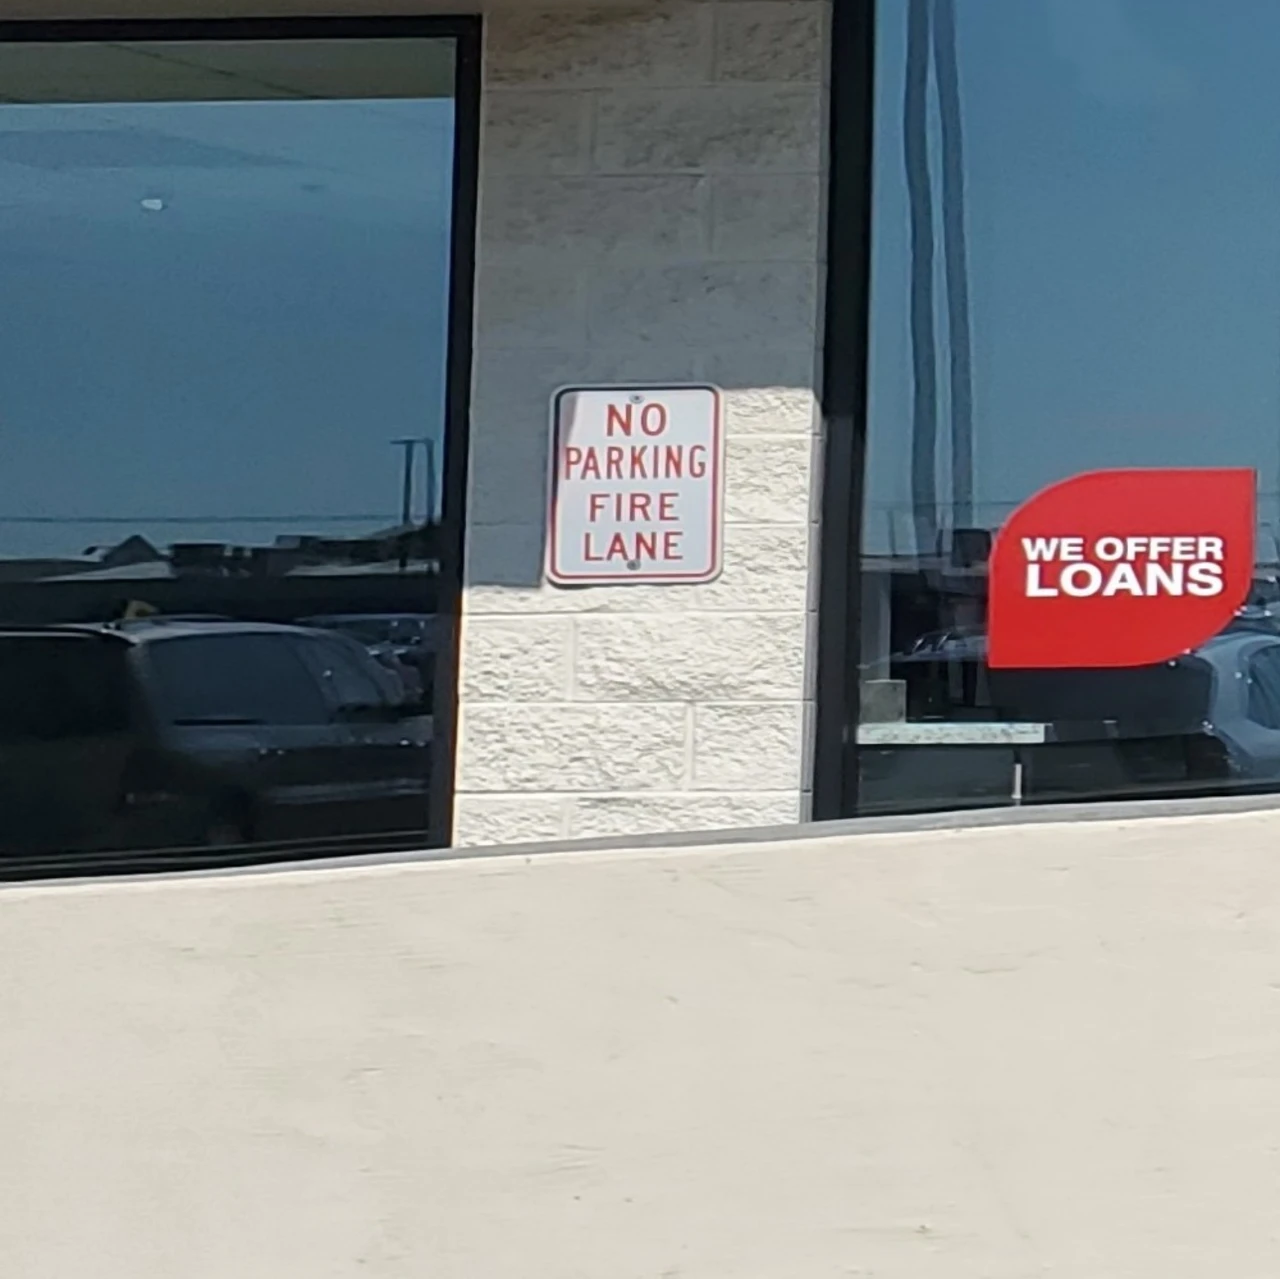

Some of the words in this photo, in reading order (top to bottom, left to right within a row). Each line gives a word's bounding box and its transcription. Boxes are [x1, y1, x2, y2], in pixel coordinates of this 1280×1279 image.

[606, 403, 667, 437] NO
[564, 444, 707, 480] PARKING
[589, 493, 680, 522] FIRE
[584, 531, 684, 562] LANE
[1021, 537, 1085, 561] WE
[1094, 536, 1225, 561] OFFER
[1025, 562, 1224, 597] LOANS
